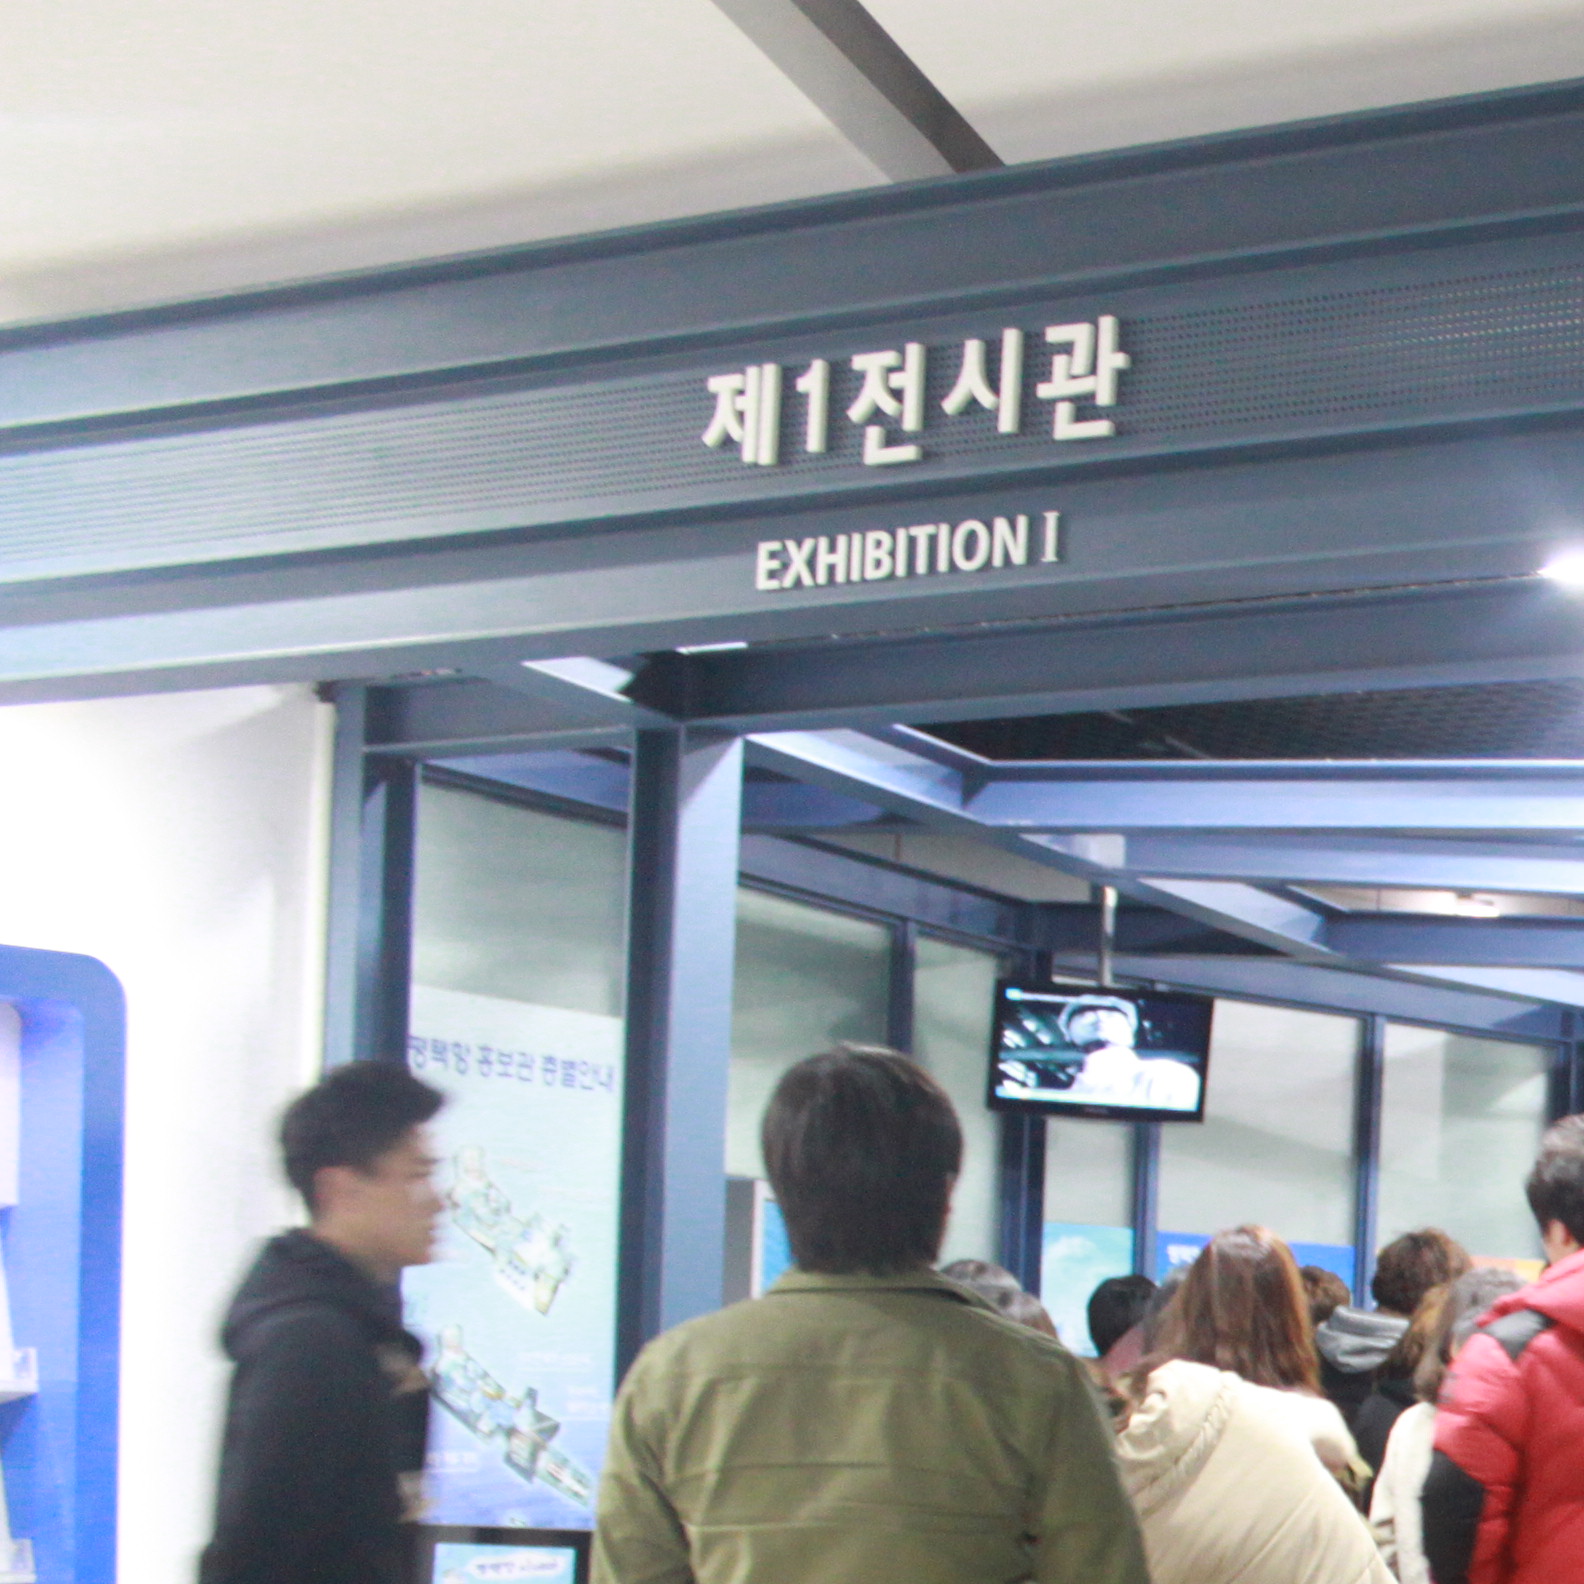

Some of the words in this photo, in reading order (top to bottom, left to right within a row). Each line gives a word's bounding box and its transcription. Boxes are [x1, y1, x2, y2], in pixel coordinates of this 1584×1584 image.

[702, 314, 1131, 466] 제1전시관
[755, 514, 1029, 591] EXHIBITION
[477, 1045, 535, 1082] 홍보관
[542, 1054, 615, 1093] 층별안내
